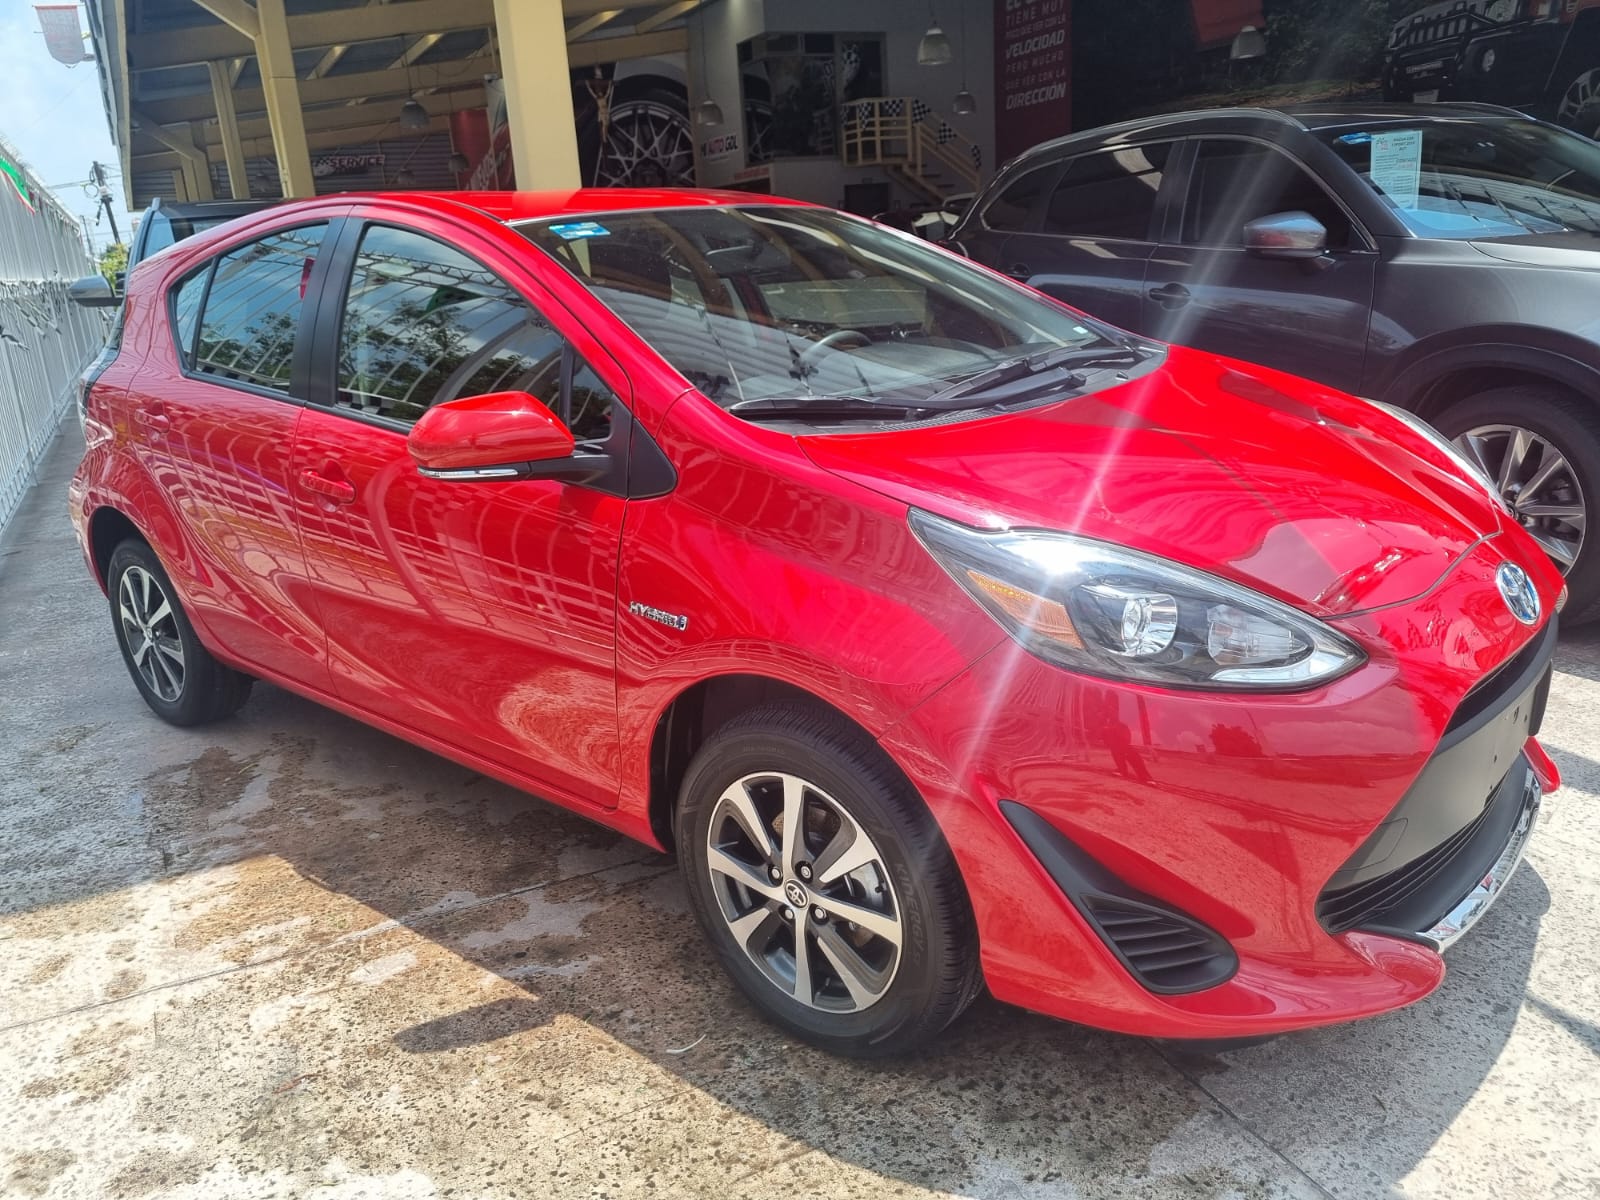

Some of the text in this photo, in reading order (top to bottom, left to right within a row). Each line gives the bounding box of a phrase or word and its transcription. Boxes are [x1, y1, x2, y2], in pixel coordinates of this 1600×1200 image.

[1005, 29, 1065, 59] VELOCIDAD
[1032, 50, 1064, 67] MUCHO
[329, 155, 385, 168] SERVICE
[894, 863, 925, 952] KINERGY
